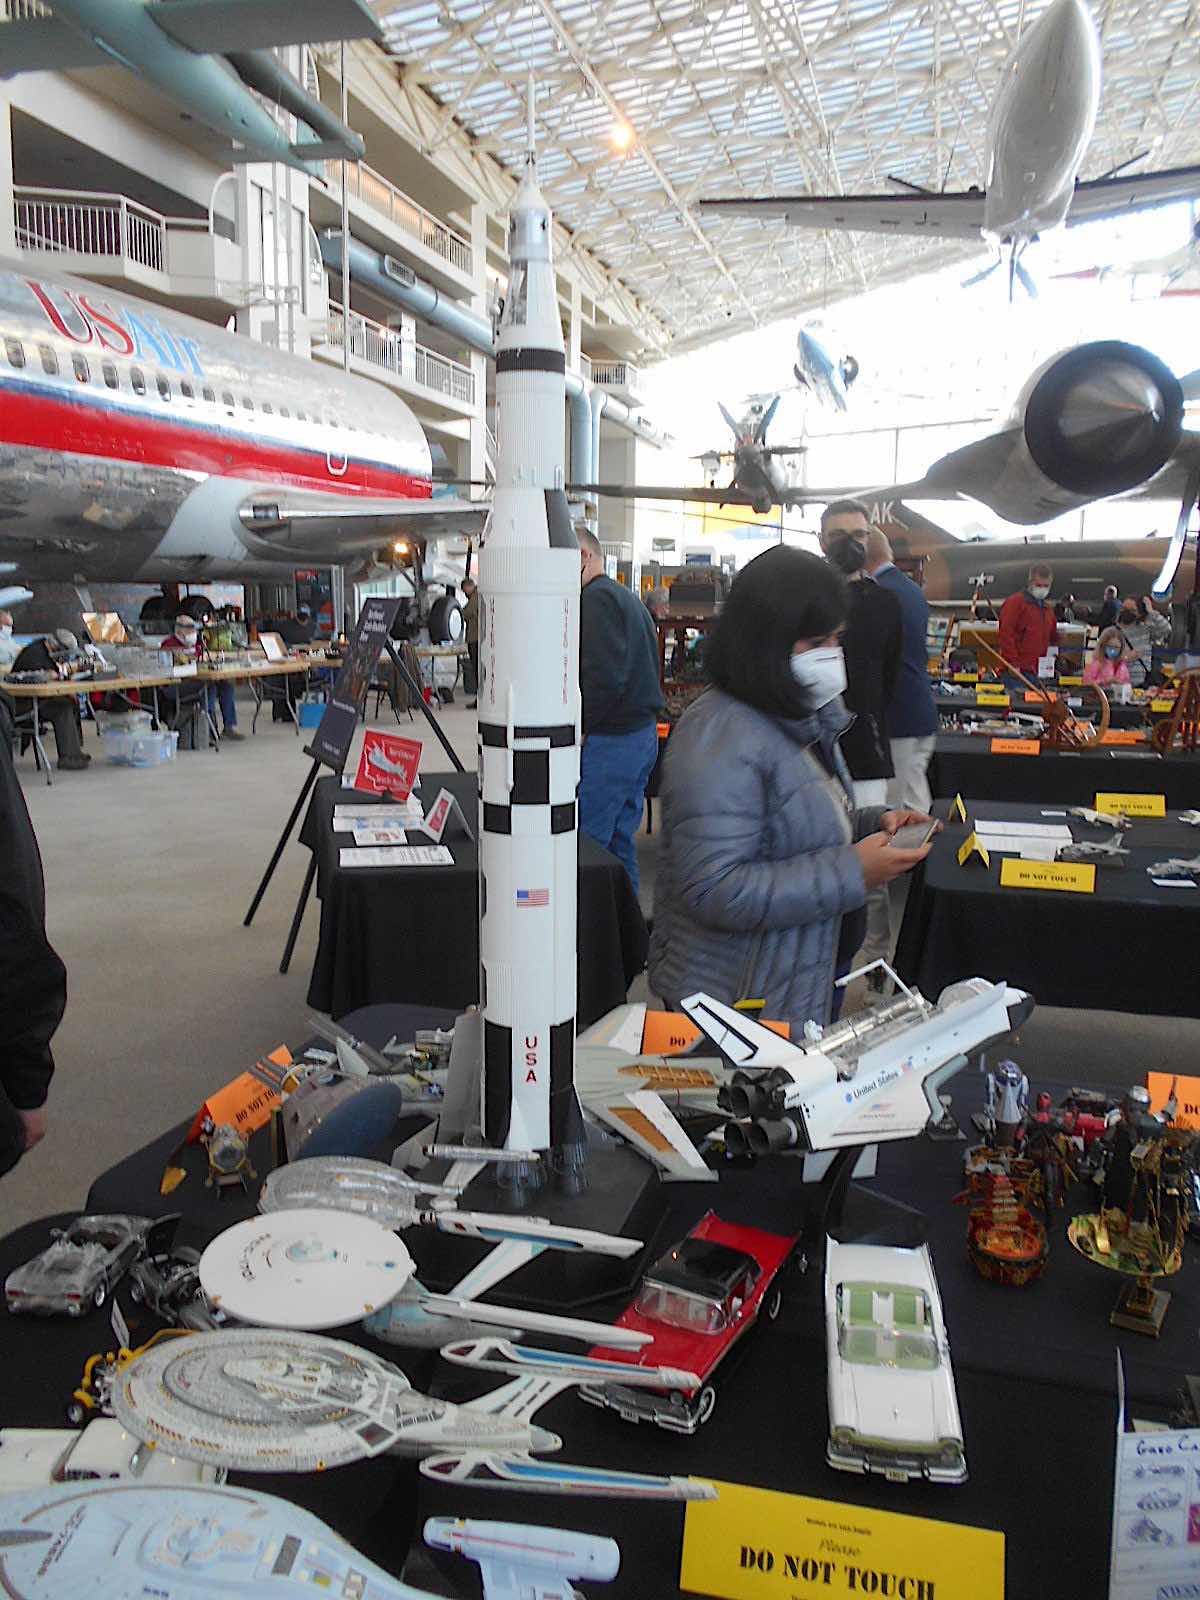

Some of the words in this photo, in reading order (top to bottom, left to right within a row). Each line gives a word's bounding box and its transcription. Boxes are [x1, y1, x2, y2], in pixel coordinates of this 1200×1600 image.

[852, 1080, 879, 1099] United
[739, 1545, 775, 1572] DO
[783, 1554, 837, 1586] NOT
[844, 1565, 937, 1600] TOUCH
